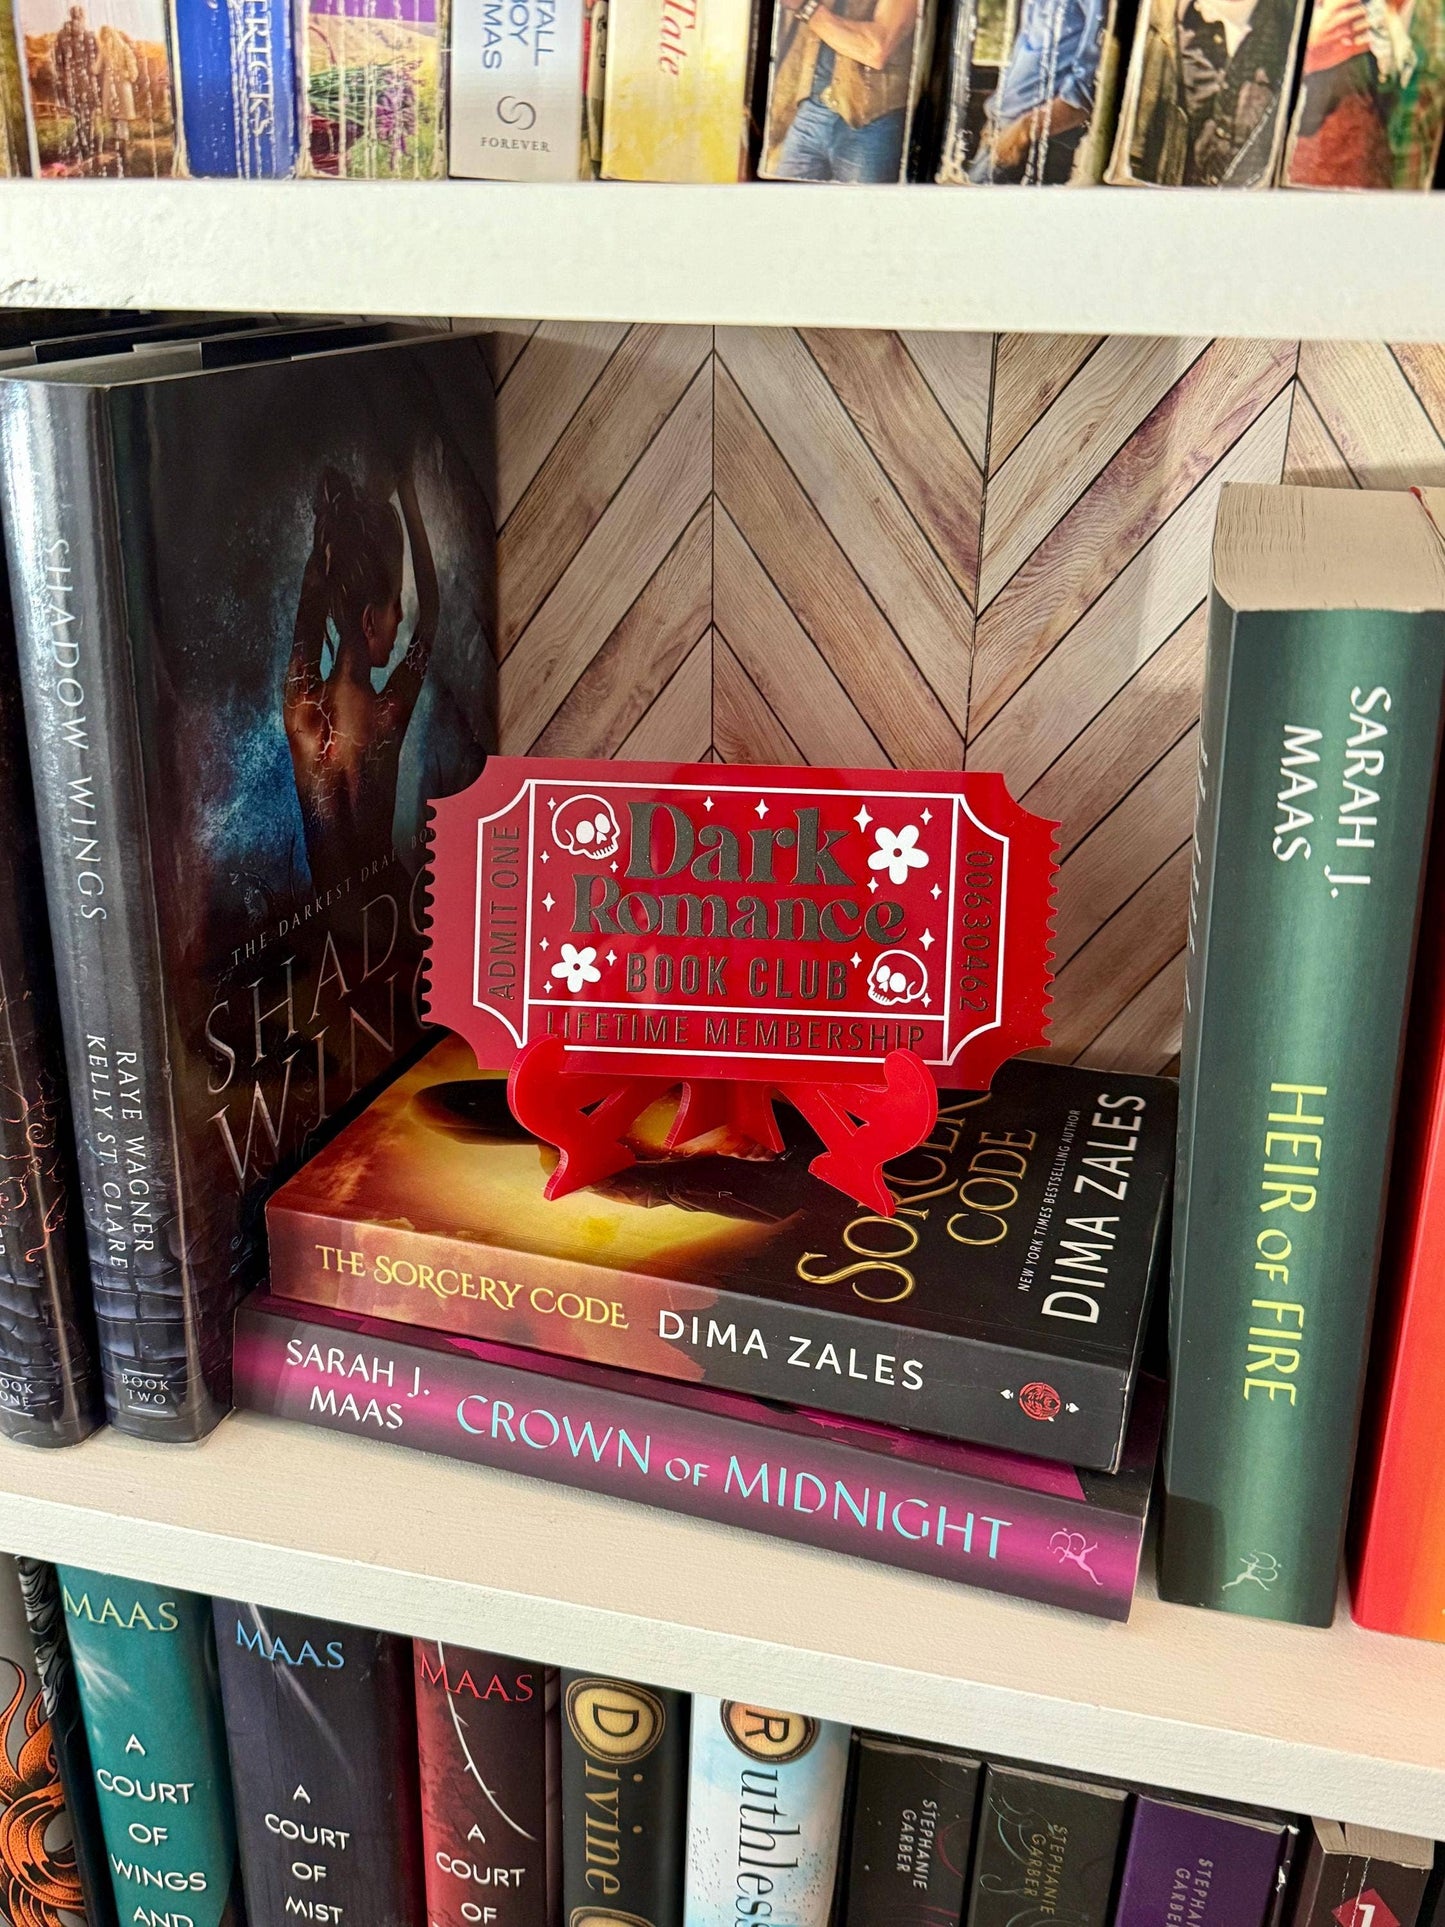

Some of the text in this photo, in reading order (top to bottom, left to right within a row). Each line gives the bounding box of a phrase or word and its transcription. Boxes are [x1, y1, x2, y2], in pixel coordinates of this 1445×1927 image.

[479, 136, 551, 154] FOREVER
[45, 538, 90, 750] SHADOW
[1272, 723, 1324, 863] MAAS
[1323, 685, 1393, 899] SARAH J.
[67, 775, 107, 920] WINGS
[623, 801, 857, 887] Dark
[231, 931, 268, 967] THE
[278, 877, 352, 938] DARKEST
[487, 825, 521, 1001] ADMIT ONE
[569, 873, 908, 946] Romance
[959, 849, 995, 1013] 00630462
[625, 952, 848, 1001] BOOK CLUB
[546, 1010, 925, 1052] LIFETIME MEMBERSHIP
[86, 1033, 129, 1269] KELLY ST. CLARE
[116, 1050, 155, 1252] RAYE WAGNER
[946, 1128, 1039, 1246] CODE
[1017, 1108, 1081, 1292] NEW YORK TIMES BESTSELLING AUTHOR
[1040, 1092, 1147, 1324] DIMA ZALES
[1243, 1081, 1328, 1407] HEIR OF FIRE
[315, 1244, 630, 1330] THE SORCERY CODE
[121, 1373, 170, 1391] BOOK
[285, 1338, 430, 1398] SARAH J.
[657, 1309, 924, 1391] DIMA ZALES
[126, 1388, 167, 1405] TWO
[309, 1385, 403, 1430] MAAS
[455, 1394, 1013, 1560] CROWN OF MIDNIGHT
[62, 1584, 180, 1632] MAAS
[235, 1618, 346, 1670] MAAS
[419, 1651, 534, 1703] MAAS
[124, 1733, 147, 1757] A
[96, 1768, 196, 1805] COURT
[292, 1783, 312, 1804] A
[585, 1701, 645, 1895] Divine
[128, 1821, 169, 1847] OF
[264, 1812, 351, 1851] COURT
[466, 1823, 487, 1845] A
[895, 1808, 917, 1874] GARBER
[912, 1798, 938, 1891] STEPHANIE
[110, 1853, 208, 1893] WINGS
[291, 1861, 328, 1883] OF
[434, 1850, 526, 1888] COURT
[1022, 1833, 1047, 1899] GARBER
[1040, 1823, 1069, 1916] STEPHANIE
[285, 1895, 344, 1925] MIST
[460, 1902, 498, 1926] OF
